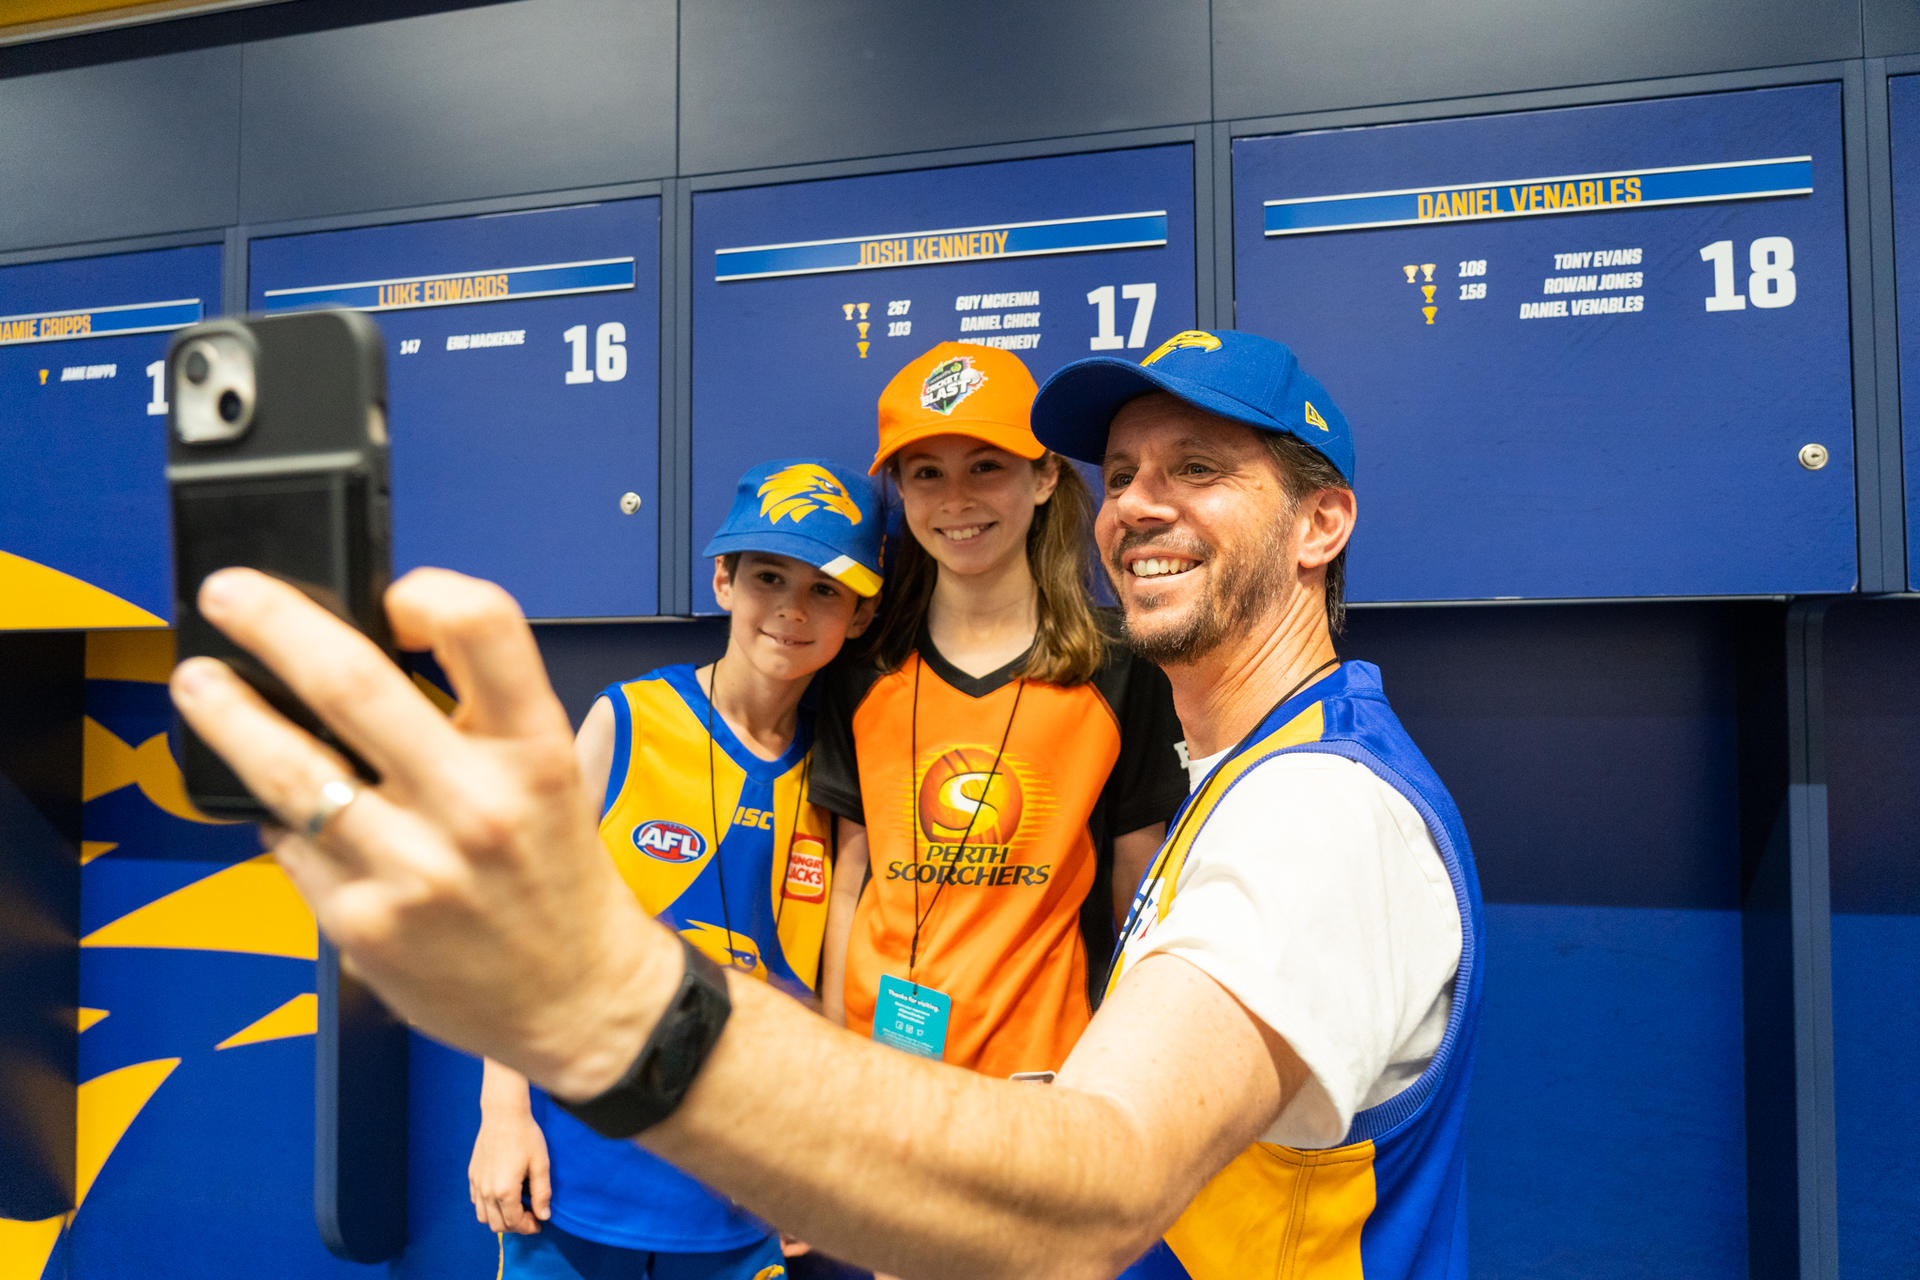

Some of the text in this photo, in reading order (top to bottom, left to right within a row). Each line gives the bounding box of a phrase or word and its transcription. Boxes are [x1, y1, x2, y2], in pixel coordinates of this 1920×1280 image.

[1418, 177, 1642, 219] DANIEL VENABLES
[857, 231, 1009, 265] JOSH KENNEDY
[1554, 248, 1643, 270] TONY EVANS
[1543, 271, 1644, 294] ROWAN JONES
[1700, 236, 1796, 312] 18
[378, 275, 509, 306] LUKE EDWARDS
[955, 290, 1040, 311] GUY MCKENNA
[1086, 283, 1157, 351] 17
[1519, 295, 1644, 319] DANIEL VENABLES
[40, 315, 92, 337] CRIPPS
[960, 312, 1041, 332] DANIEL CHICK
[563, 322, 627, 384] 16
[986, 333, 1042, 350] KENNEDY
[921, 379, 972, 408] BLAST
[733, 806, 773, 830] ISC
[638, 827, 699, 858] AFL
[926, 845, 1009, 864] PERTH
[886, 861, 1051, 886] SCORCHERS
